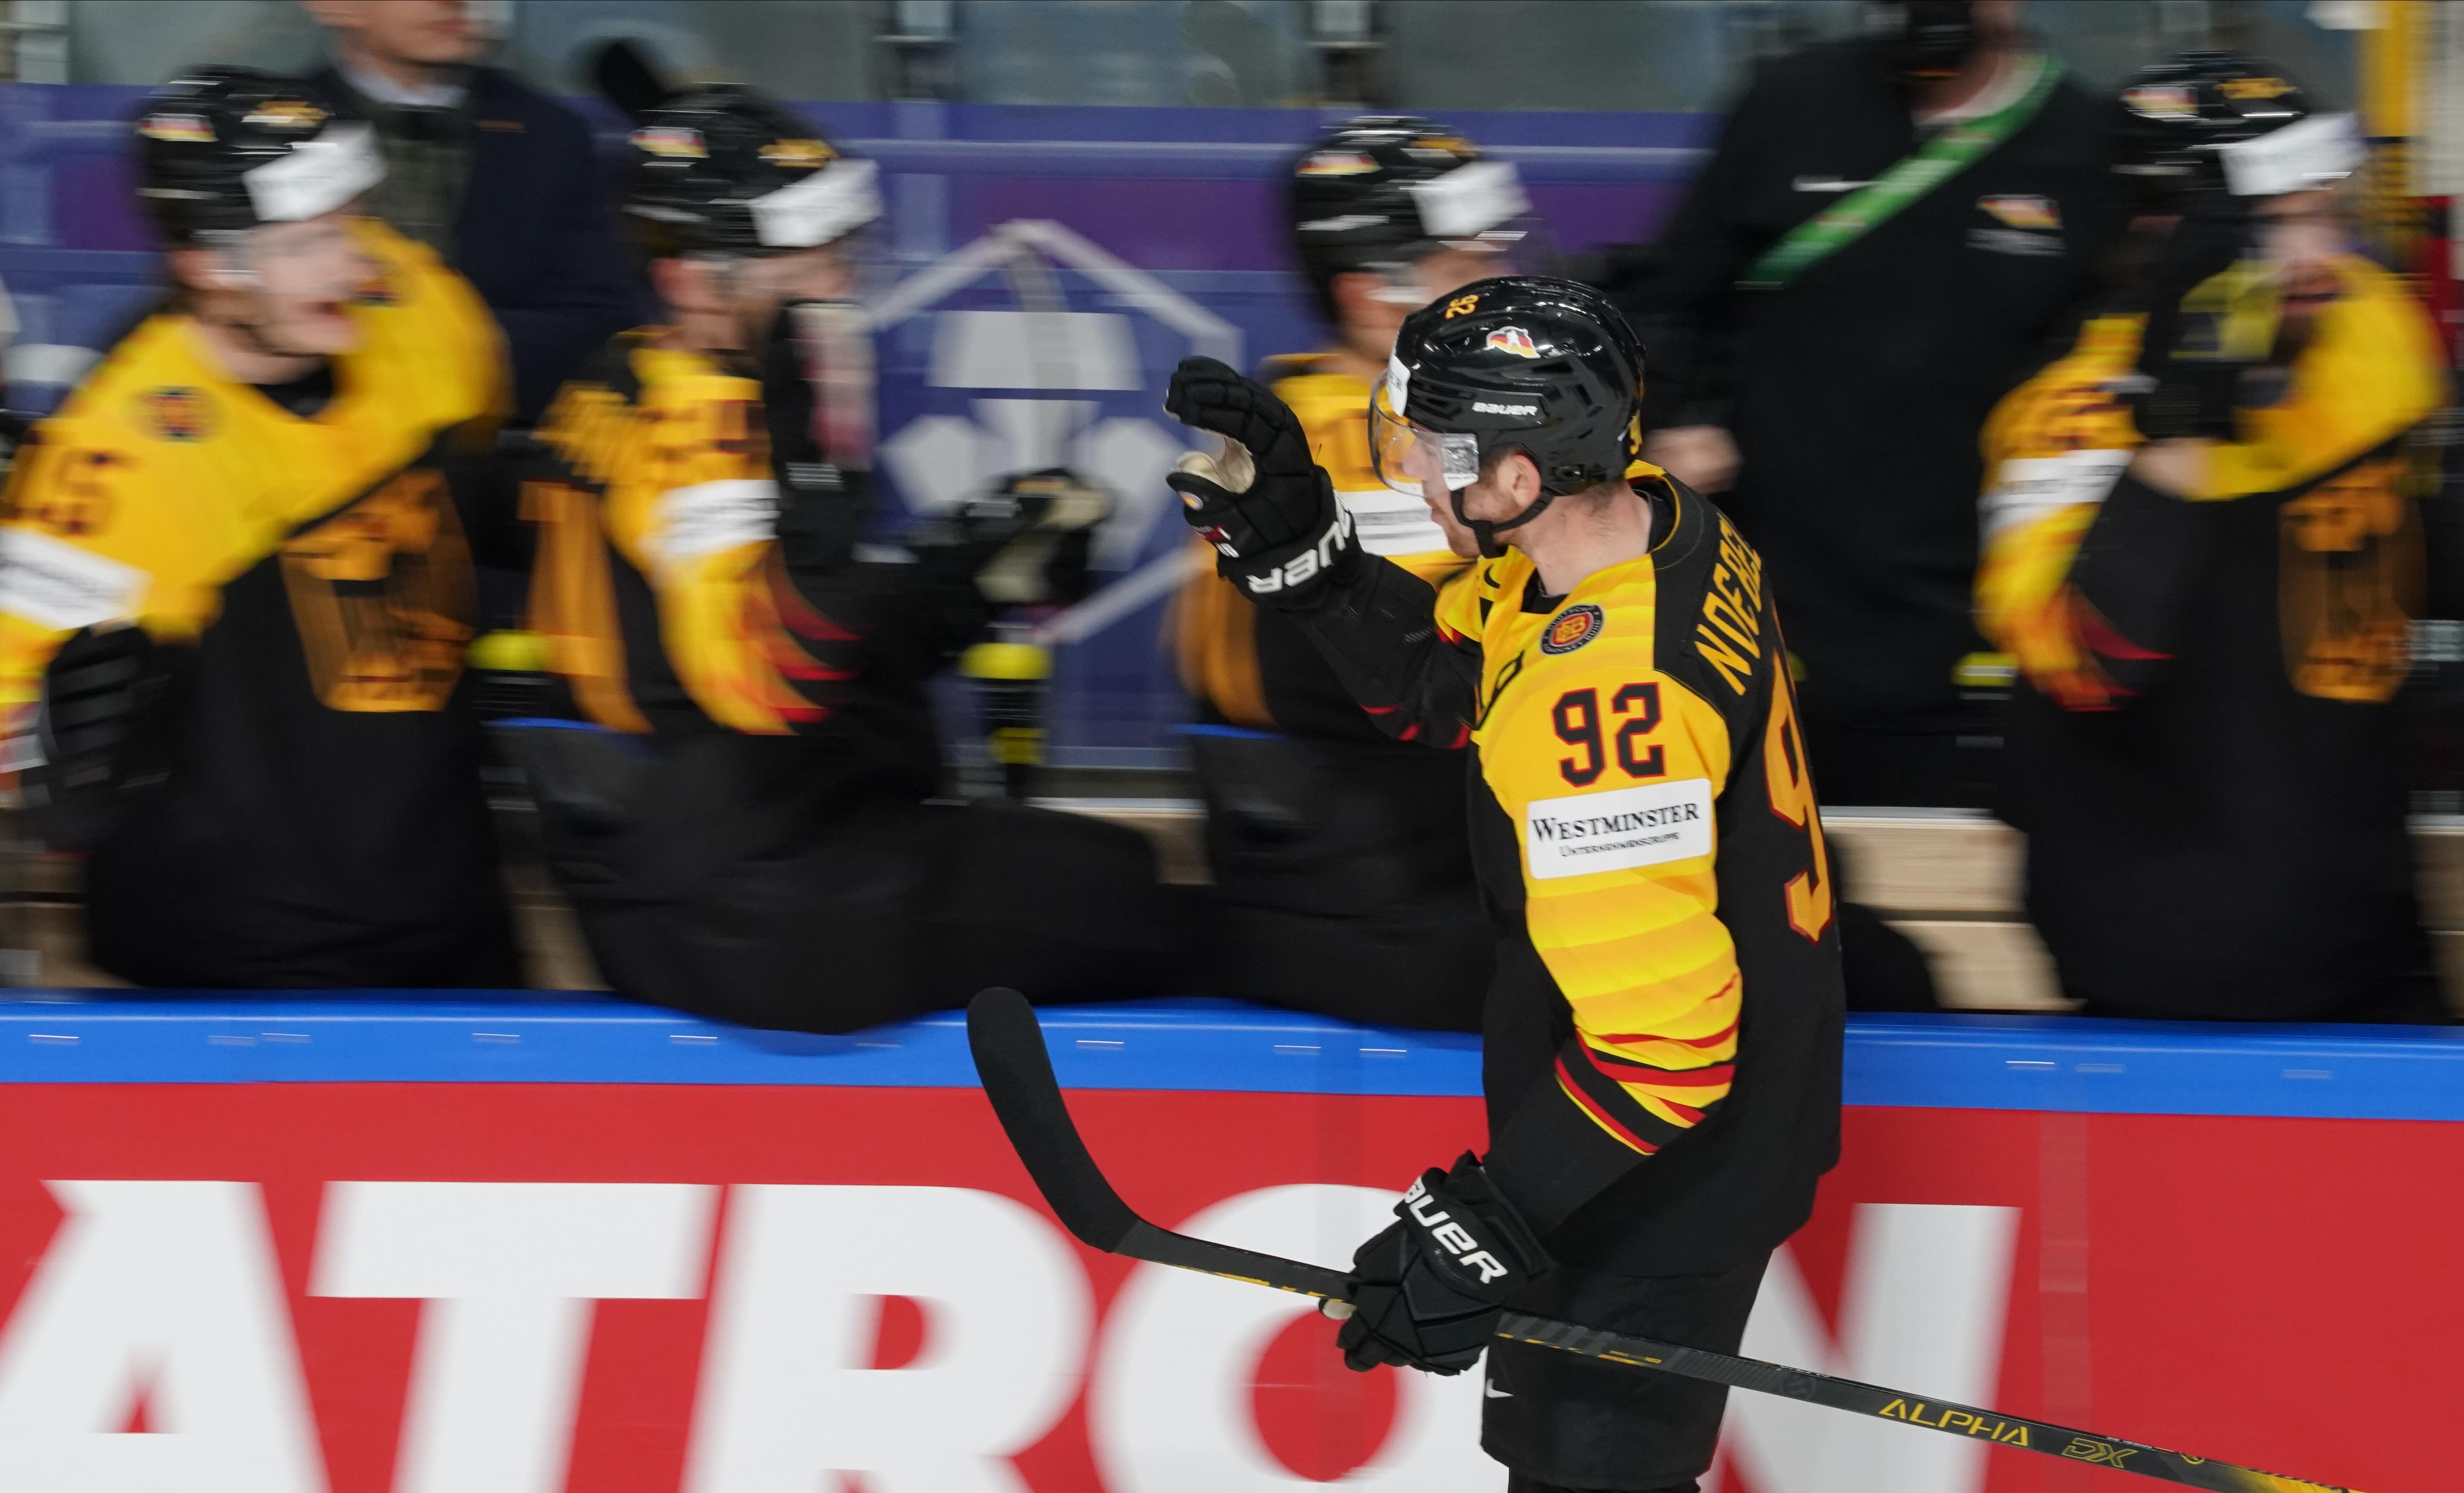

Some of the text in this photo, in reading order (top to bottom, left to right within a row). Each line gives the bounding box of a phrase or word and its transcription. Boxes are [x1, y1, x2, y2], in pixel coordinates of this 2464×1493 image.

[1471, 402, 1538, 416] BAUER
[1246, 489, 1352, 594] AUER
[1551, 682, 1667, 788] 92
[1532, 802, 1701, 843] WESTMINSTER
[1403, 1175, 1508, 1284] AUER
[1879, 1398, 2029, 1446] ALPHA
